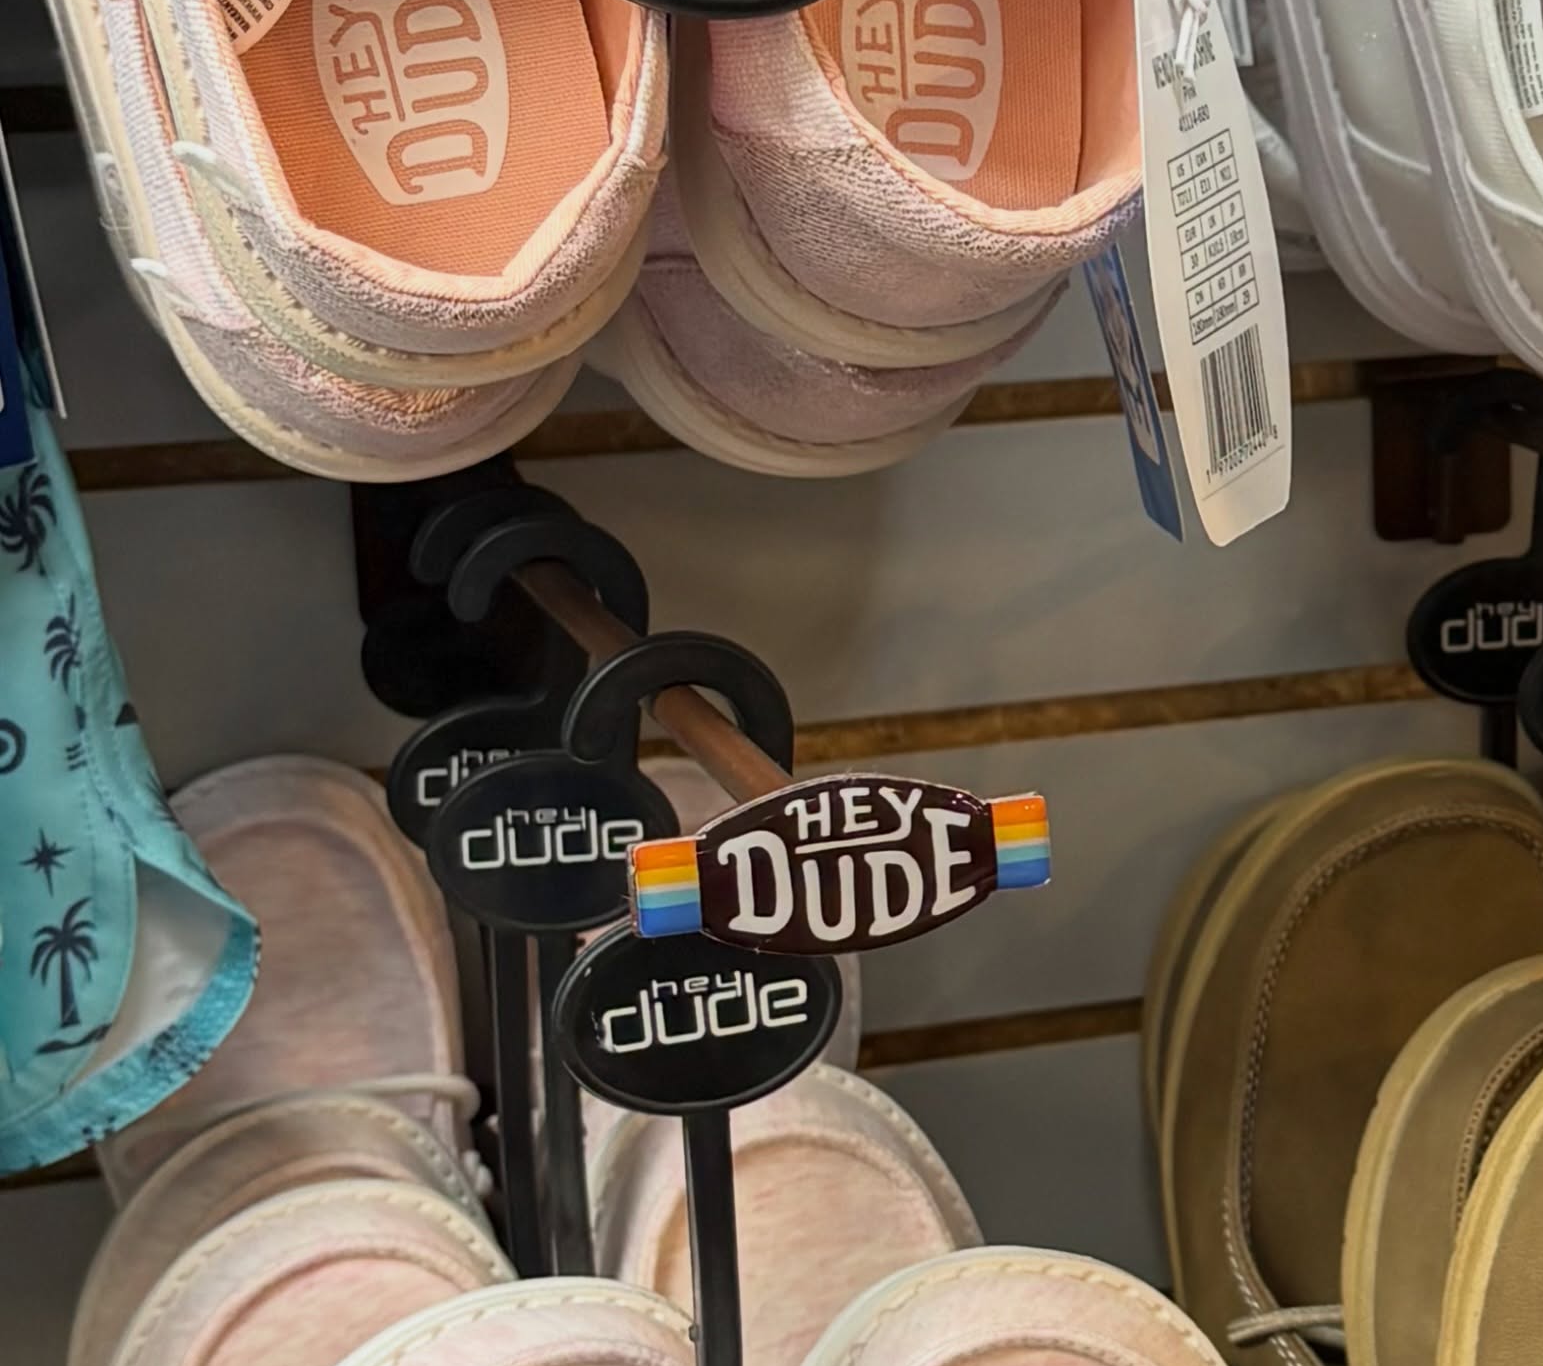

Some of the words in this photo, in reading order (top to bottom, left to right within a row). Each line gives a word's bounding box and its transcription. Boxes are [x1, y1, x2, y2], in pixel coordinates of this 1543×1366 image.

[328, 4, 405, 135] HEY
[461, 810, 644, 871] dude
[507, 806, 586, 827] hey
[785, 786, 924, 842] HEY
[717, 807, 976, 942] DUDE
[600, 971, 808, 1053] dude
[650, 969, 743, 995] hey
